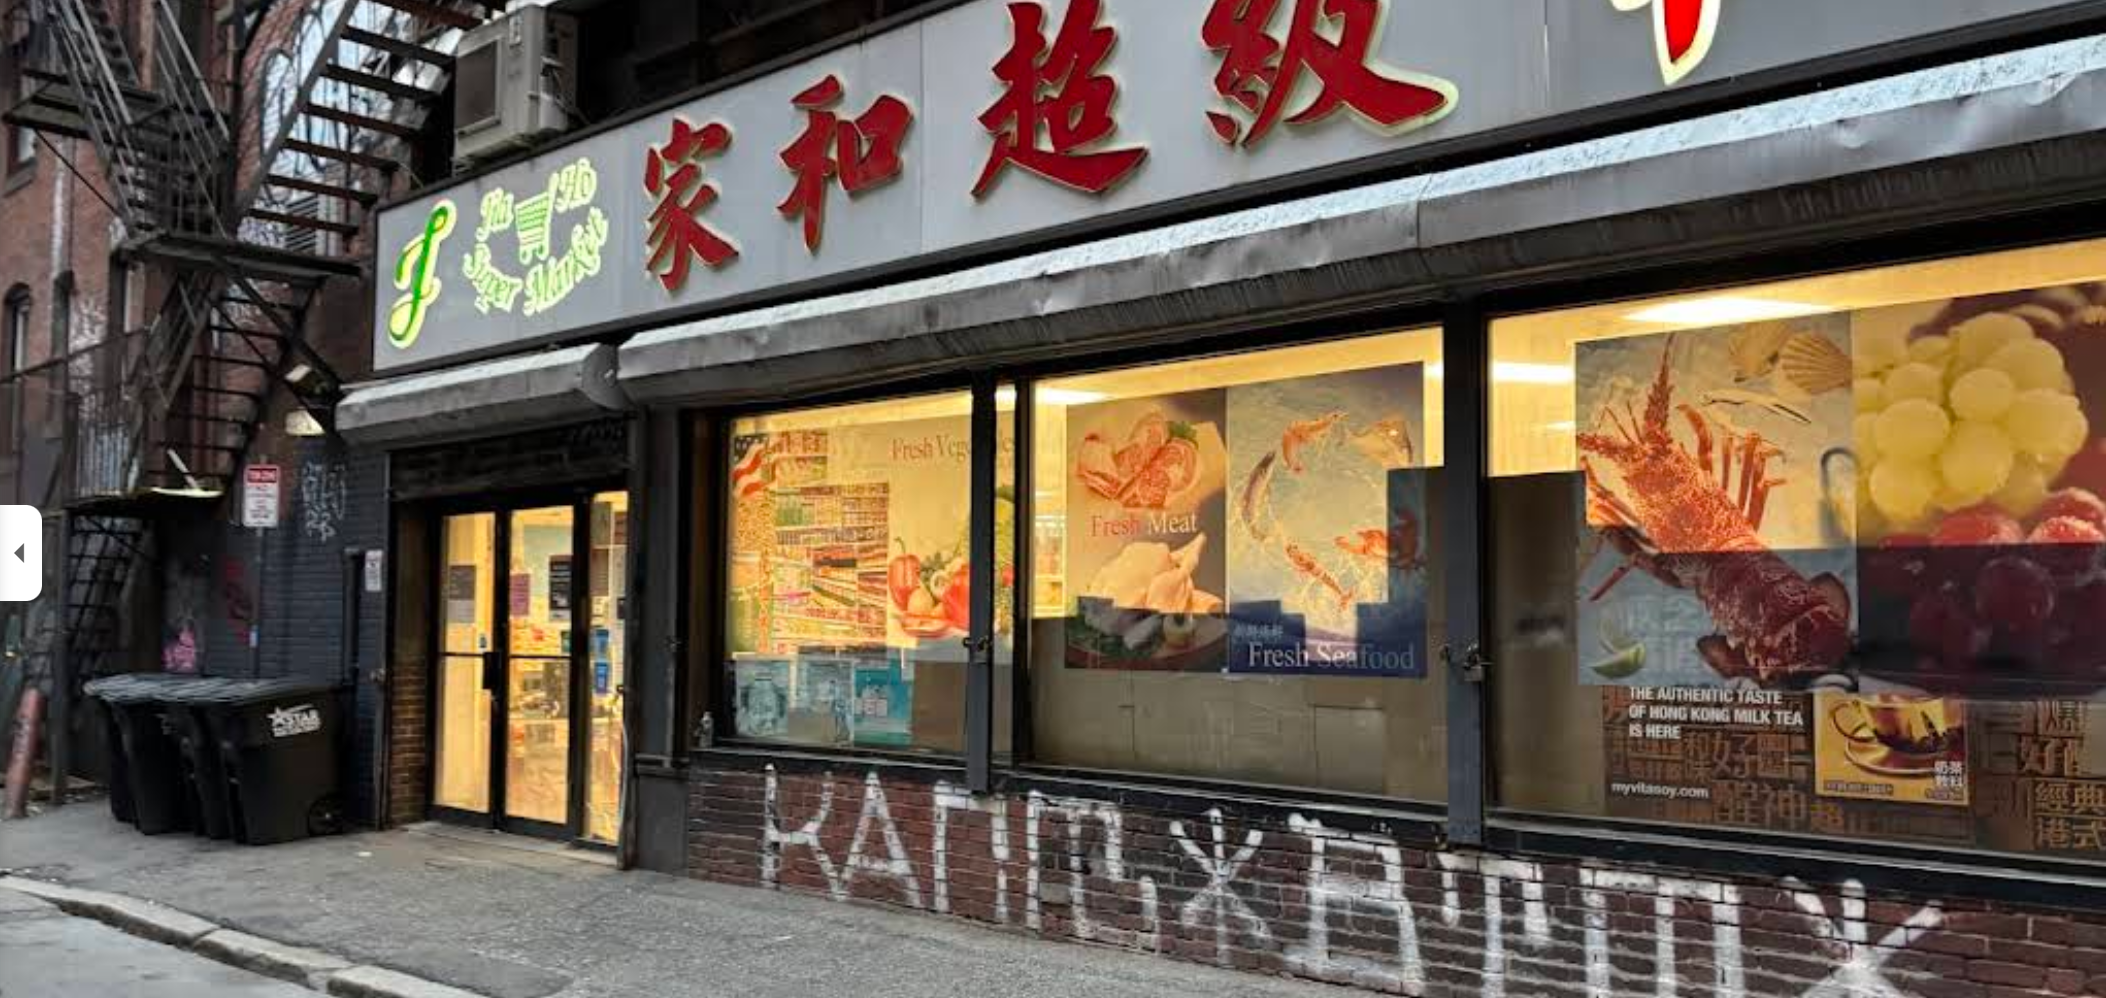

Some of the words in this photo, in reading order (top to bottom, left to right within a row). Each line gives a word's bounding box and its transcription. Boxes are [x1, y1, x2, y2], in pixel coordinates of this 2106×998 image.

[462, 242, 524, 314] Super
[521, 206, 609, 317] Market
[890, 437, 933, 461] Fresh
[1091, 514, 1140, 537] Fresh
[1148, 511, 1199, 535] Meat
[1249, 641, 1310, 668] Fresh
[1317, 641, 1415, 670] Seafood
[1629, 686, 1654, 700] THE
[1657, 687, 1734, 703] AUTHENTIC
[1737, 690, 1783, 705] TASTE
[1629, 705, 1647, 719] OF
[1649, 705, 1688, 722] HONG
[1690, 707, 1730, 723] KONG
[1733, 708, 1771, 725] MILK
[1774, 710, 1804, 726] TEA
[1629, 724, 1643, 738] IS
[1645, 725, 1682, 740] HERE
[1611, 782, 1709, 799] myvitasoy.com
